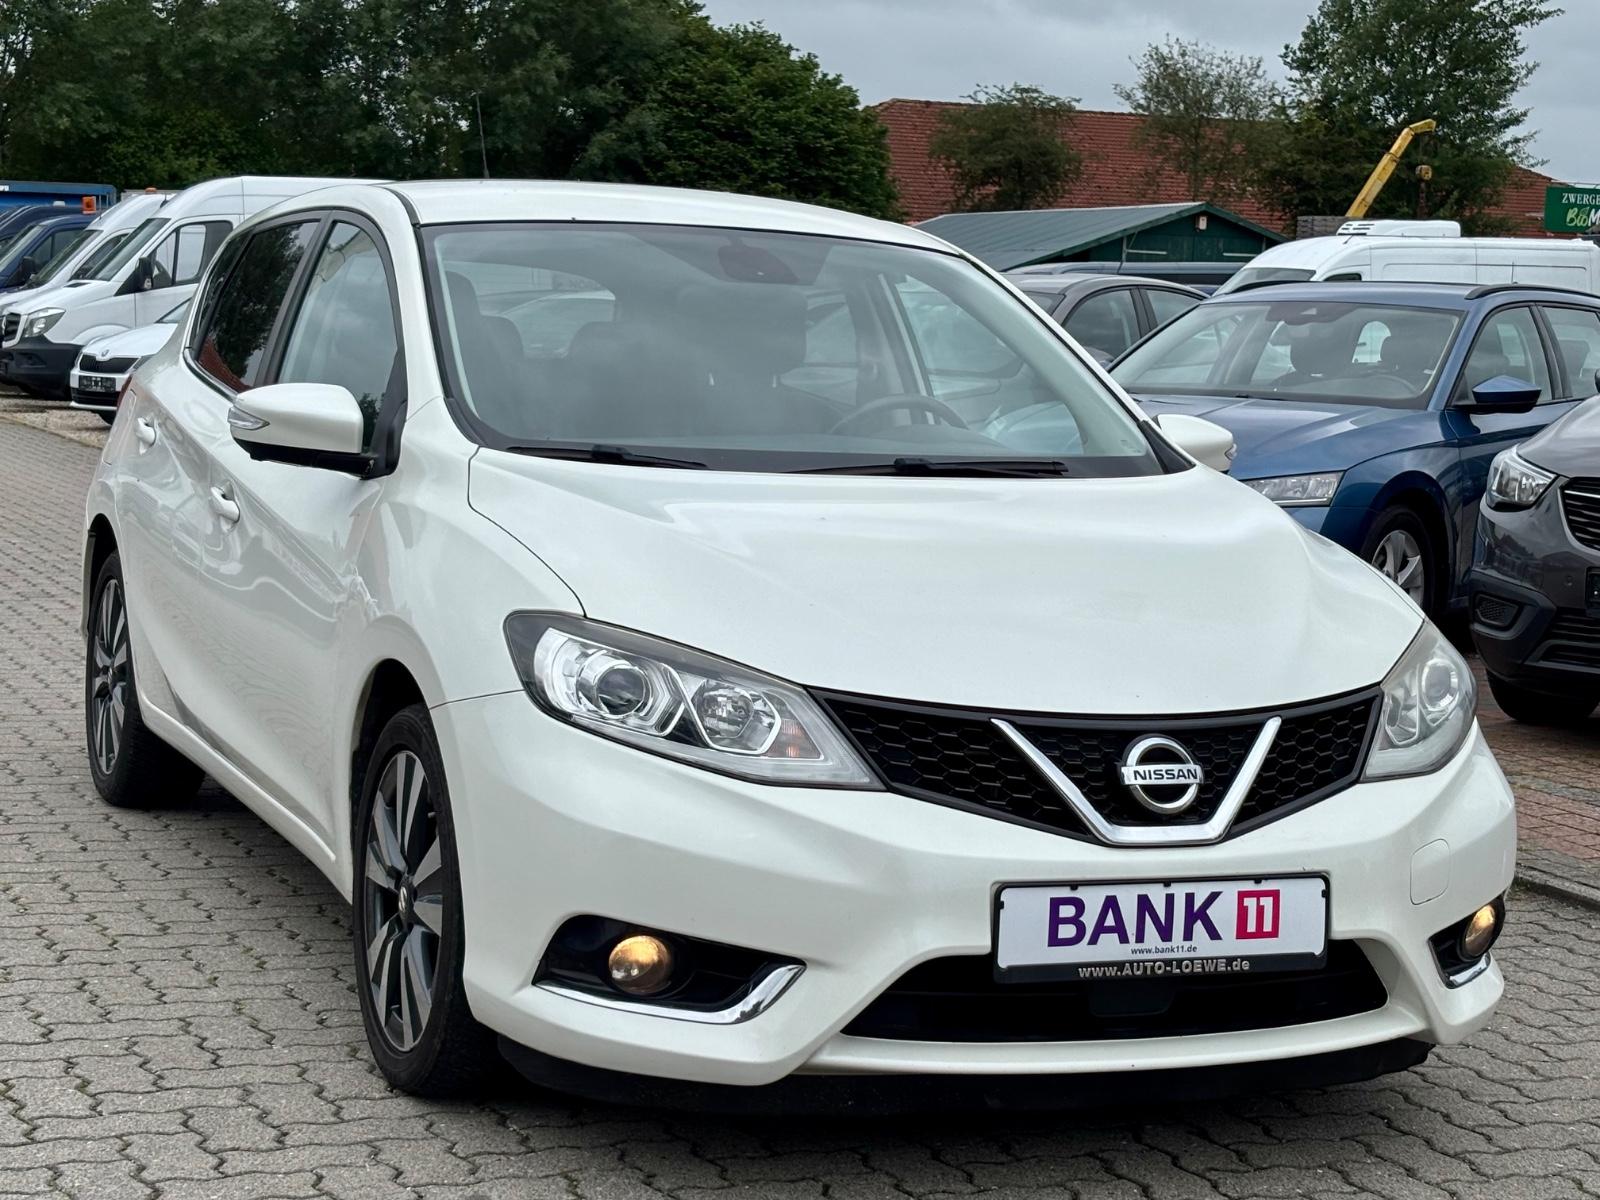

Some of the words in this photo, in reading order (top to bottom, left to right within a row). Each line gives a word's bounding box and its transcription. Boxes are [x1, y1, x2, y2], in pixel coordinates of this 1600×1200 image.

[1561, 192, 1600, 205] ZWERGE
[1133, 768, 1198, 781] NISSAN
[1047, 890, 1223, 948] BANK
[1241, 894, 1275, 935] 11
[1130, 944, 1198, 956] www.bank11.de
[1078, 958, 1251, 978] www.AUTO-LOEWE.de
